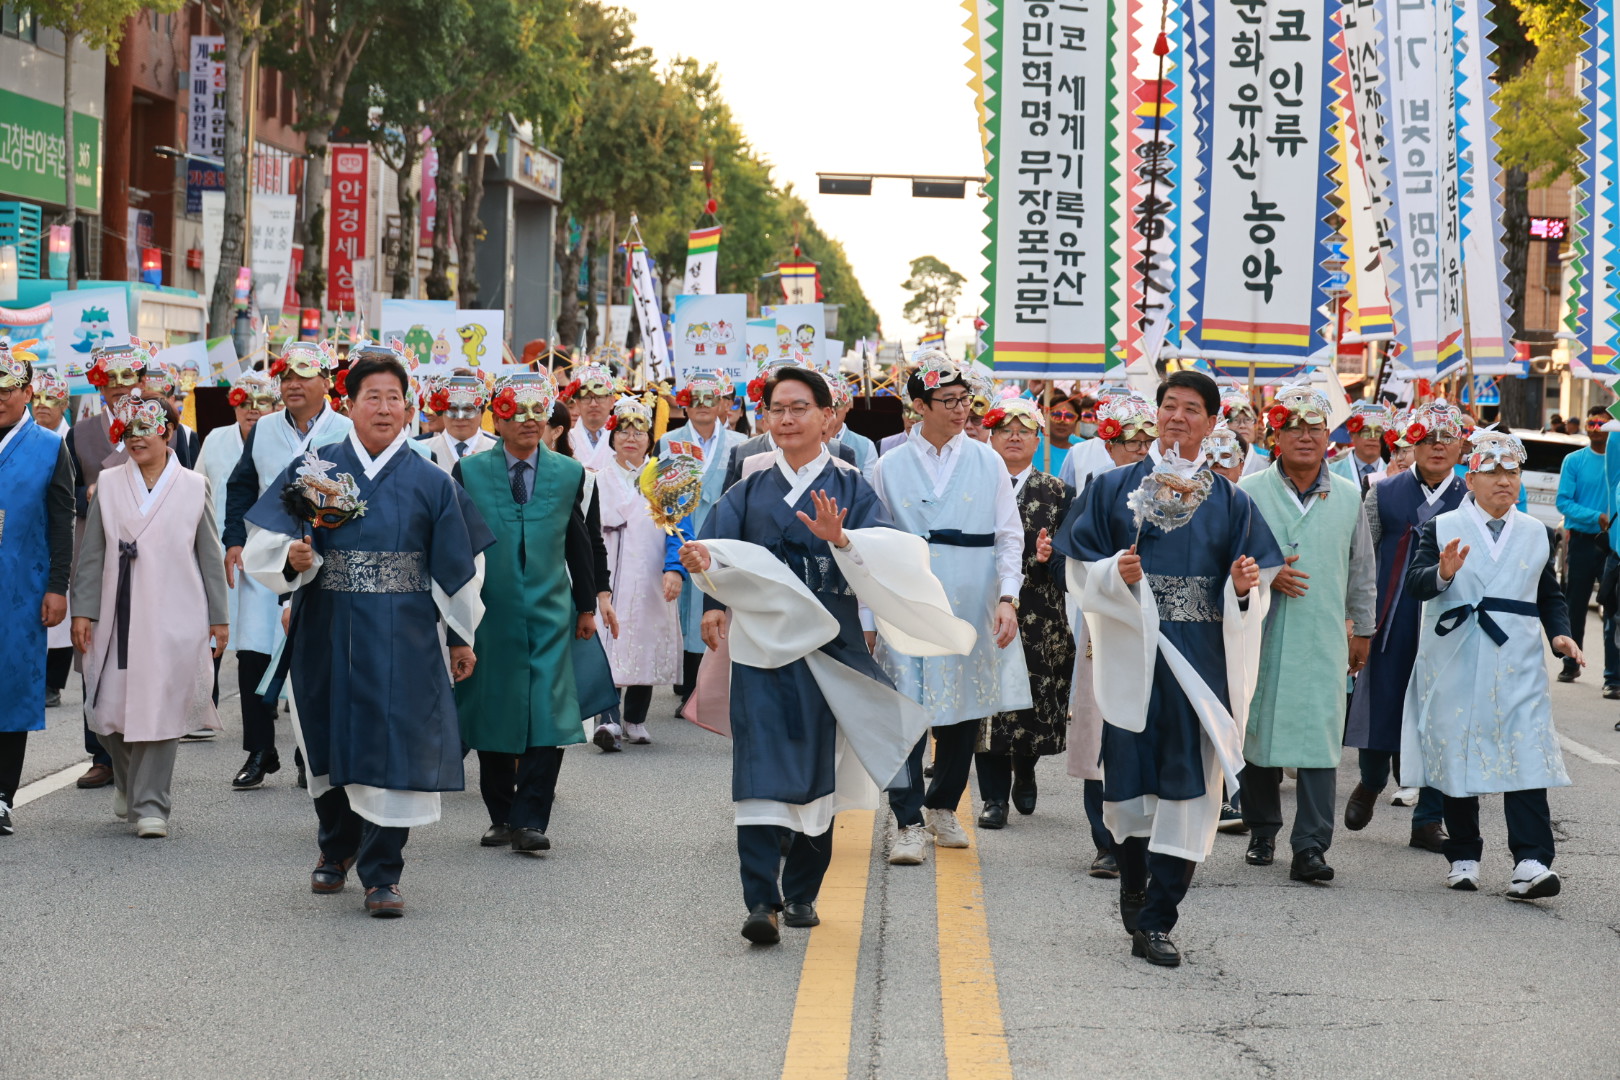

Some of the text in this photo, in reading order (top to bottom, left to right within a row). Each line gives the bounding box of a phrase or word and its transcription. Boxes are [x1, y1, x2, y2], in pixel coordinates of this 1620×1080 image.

[1053, 0, 1089, 307] 코 세계기록유산
[1266, 61, 1309, 158] 인류
[334, 179, 363, 289] 안경세상
[1014, 150, 1053, 325] 무장포고문
[1242, 190, 1286, 305] 농악
